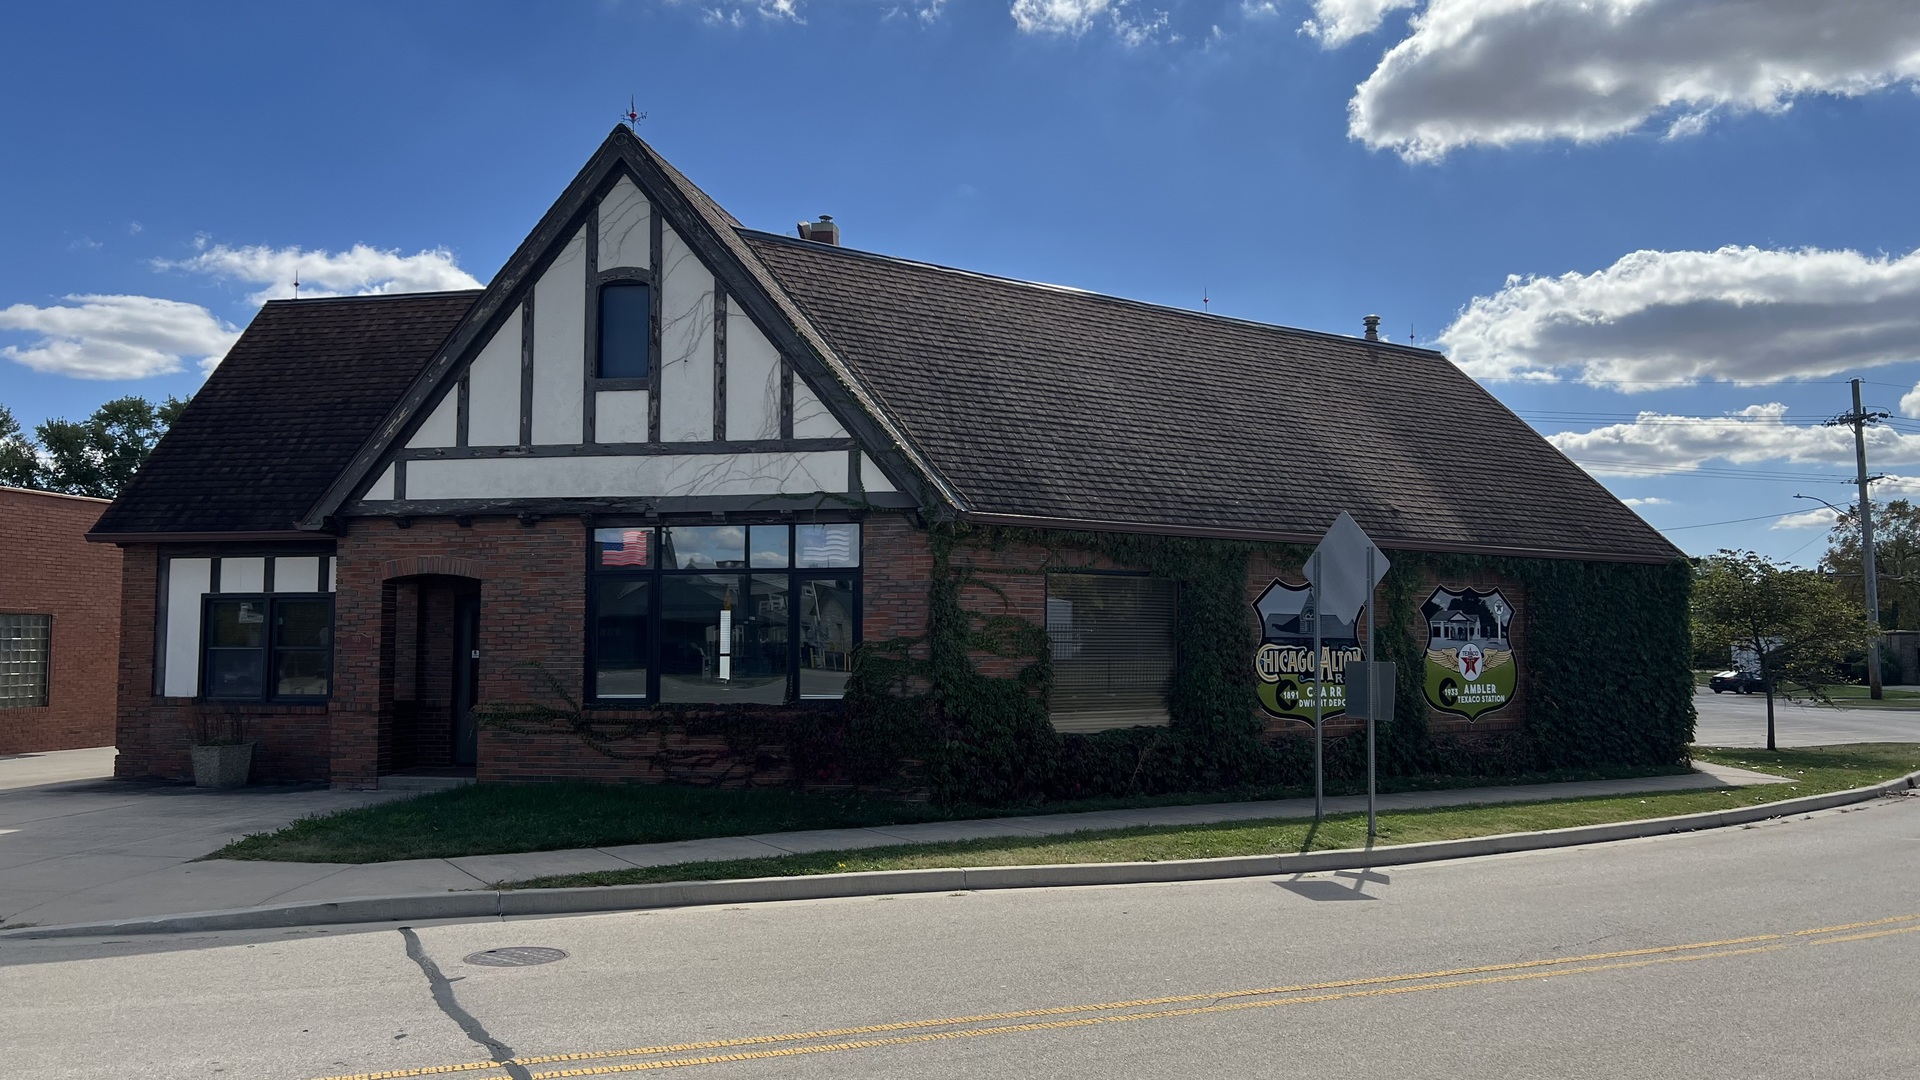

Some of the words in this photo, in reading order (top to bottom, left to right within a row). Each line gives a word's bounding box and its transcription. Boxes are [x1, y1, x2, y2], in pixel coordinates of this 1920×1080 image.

[1256, 643, 1315, 682] CHICAGO
[1330, 686, 1342, 697] RR
[1444, 688, 1459, 696] 1933
[1463, 684, 1497, 694] AMBLER
[1283, 690, 1299, 699] 1891
[1457, 695, 1481, 703] TEXACO
[1481, 694, 1506, 703] STATION
[1299, 698, 1327, 708] DWIT
[1328, 698, 1346, 707] DEPO
